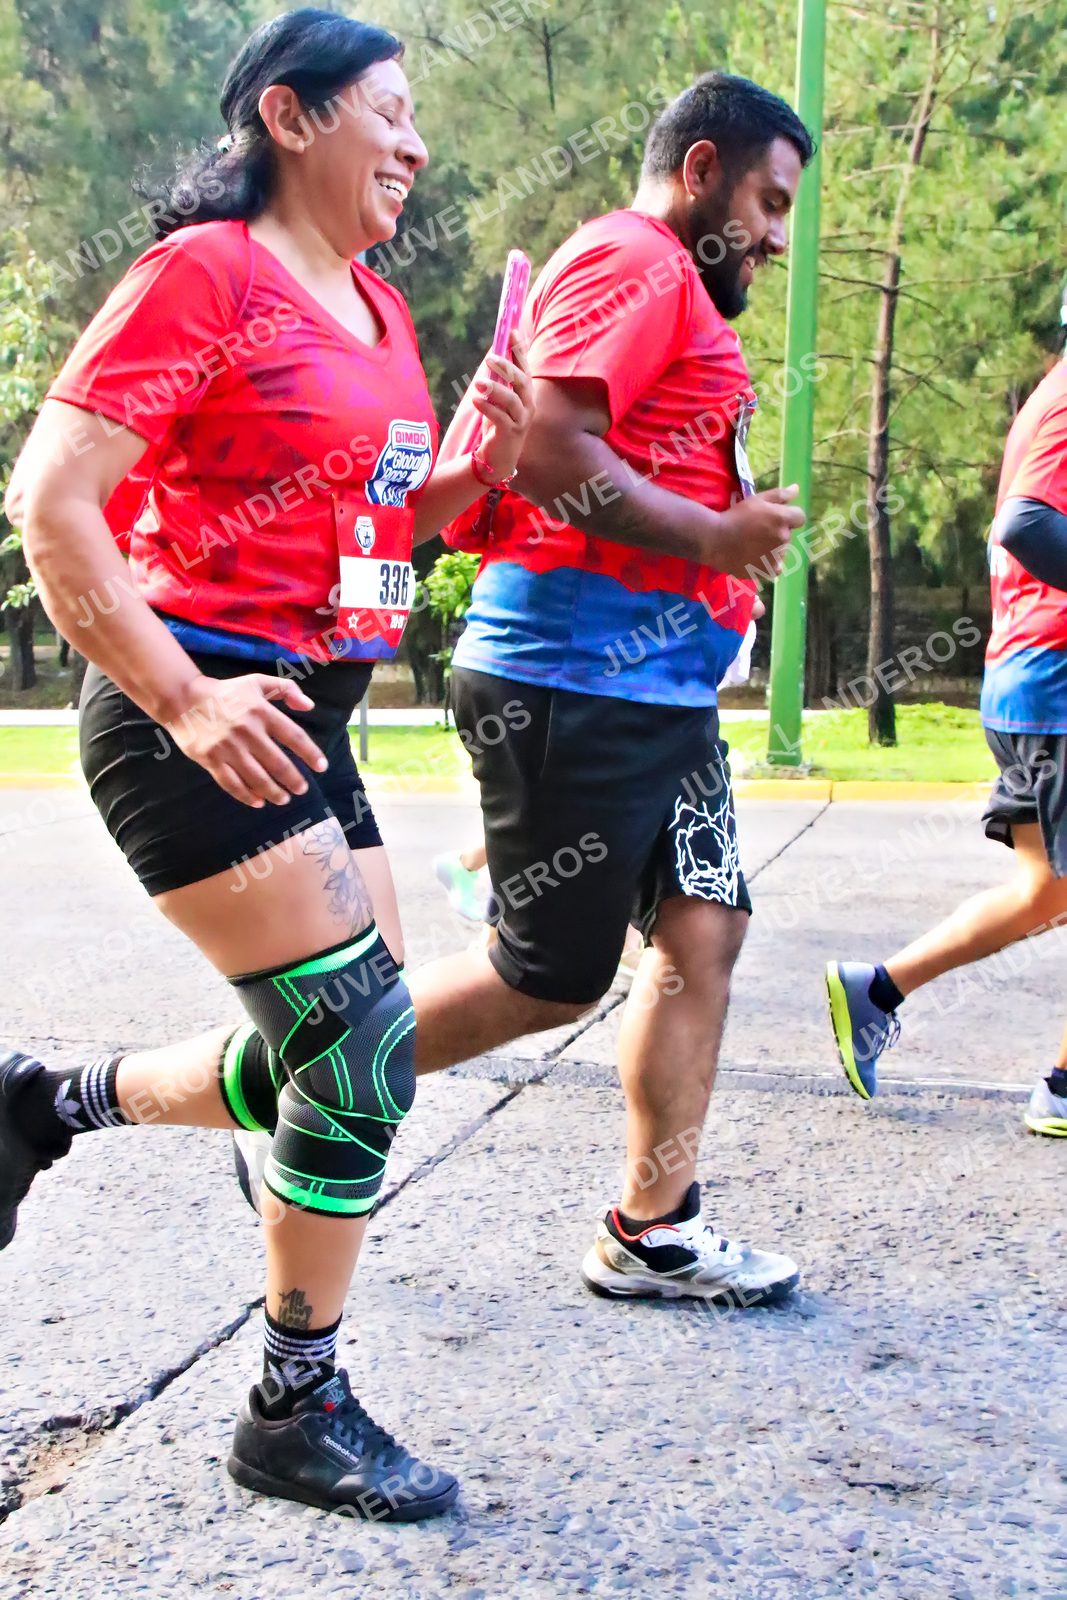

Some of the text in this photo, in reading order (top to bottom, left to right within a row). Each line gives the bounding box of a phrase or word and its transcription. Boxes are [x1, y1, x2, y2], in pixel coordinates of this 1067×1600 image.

[395, 431, 426, 445] BIMBO
[392, 450, 425, 470] Global
[380, 563, 410, 606] 336
[323, 1435, 351, 1457] Reebok
